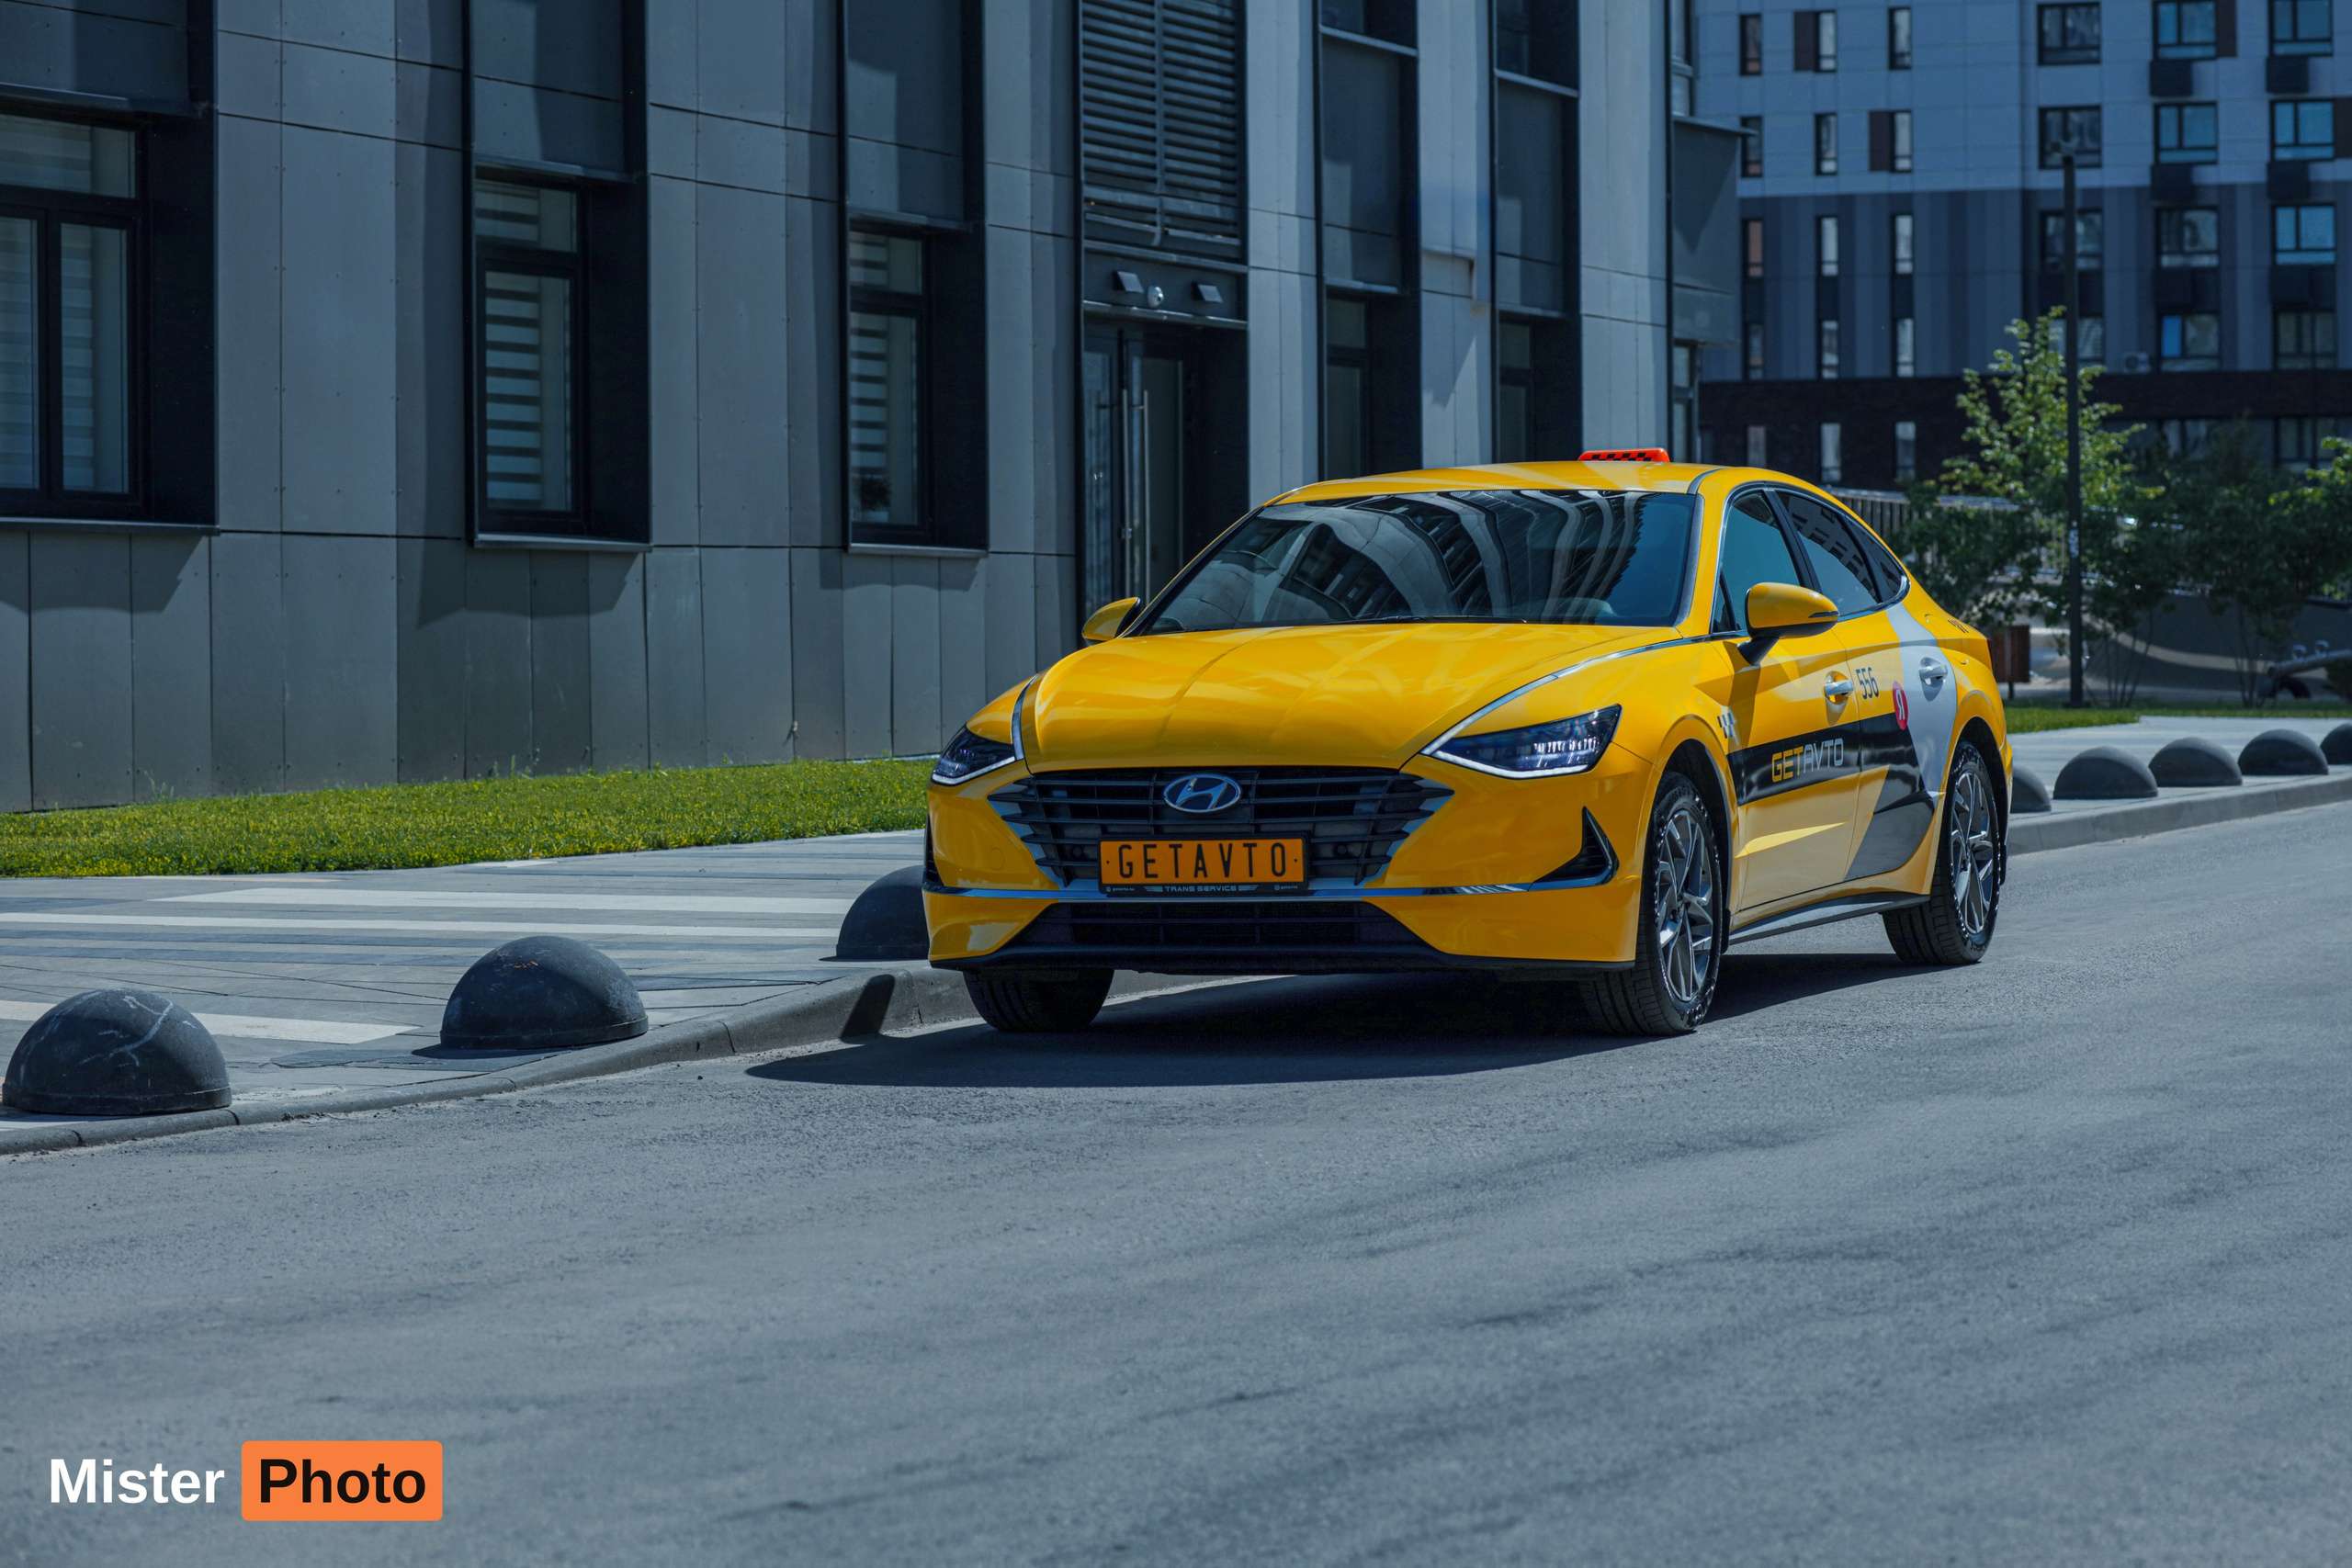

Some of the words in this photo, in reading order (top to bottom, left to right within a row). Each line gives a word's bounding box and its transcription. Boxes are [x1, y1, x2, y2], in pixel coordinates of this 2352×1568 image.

[1855, 666, 1880, 700] 556
[1771, 738, 1844, 783] GETAVTO
[1118, 842, 1286, 878] GETAVTO
